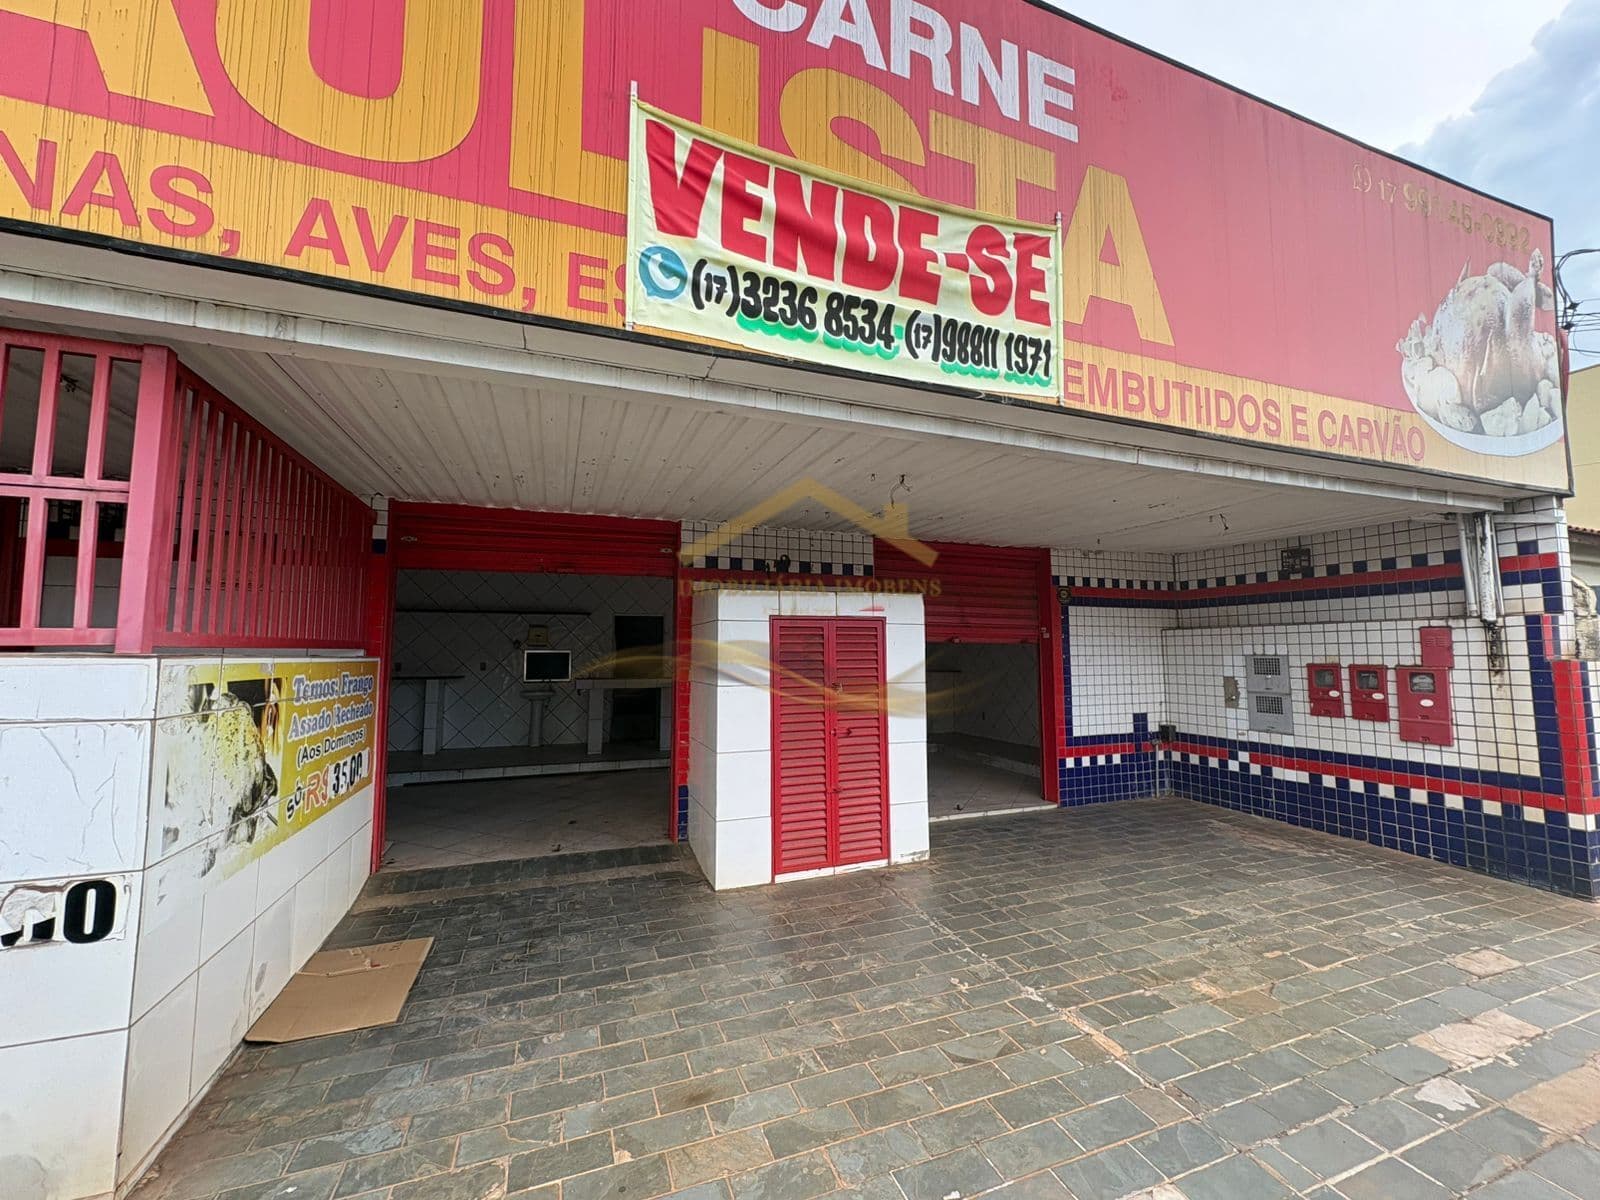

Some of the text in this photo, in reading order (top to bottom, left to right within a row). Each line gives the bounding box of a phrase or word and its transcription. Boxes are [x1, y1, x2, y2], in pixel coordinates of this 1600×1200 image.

[645, 118, 1051, 327] VENDE-SE
[284, 197, 536, 311] AVES,
[567, 251, 626, 317] E
[1291, 403, 1310, 442] E
[1318, 409, 1425, 461] CARVÃO
[823, 291, 896, 350] 8534
[1004, 332, 1052, 378] 1971
[341, 673, 373, 697] Frango
[288, 706, 332, 740] Assado
[297, 744, 321, 768] (Aos
